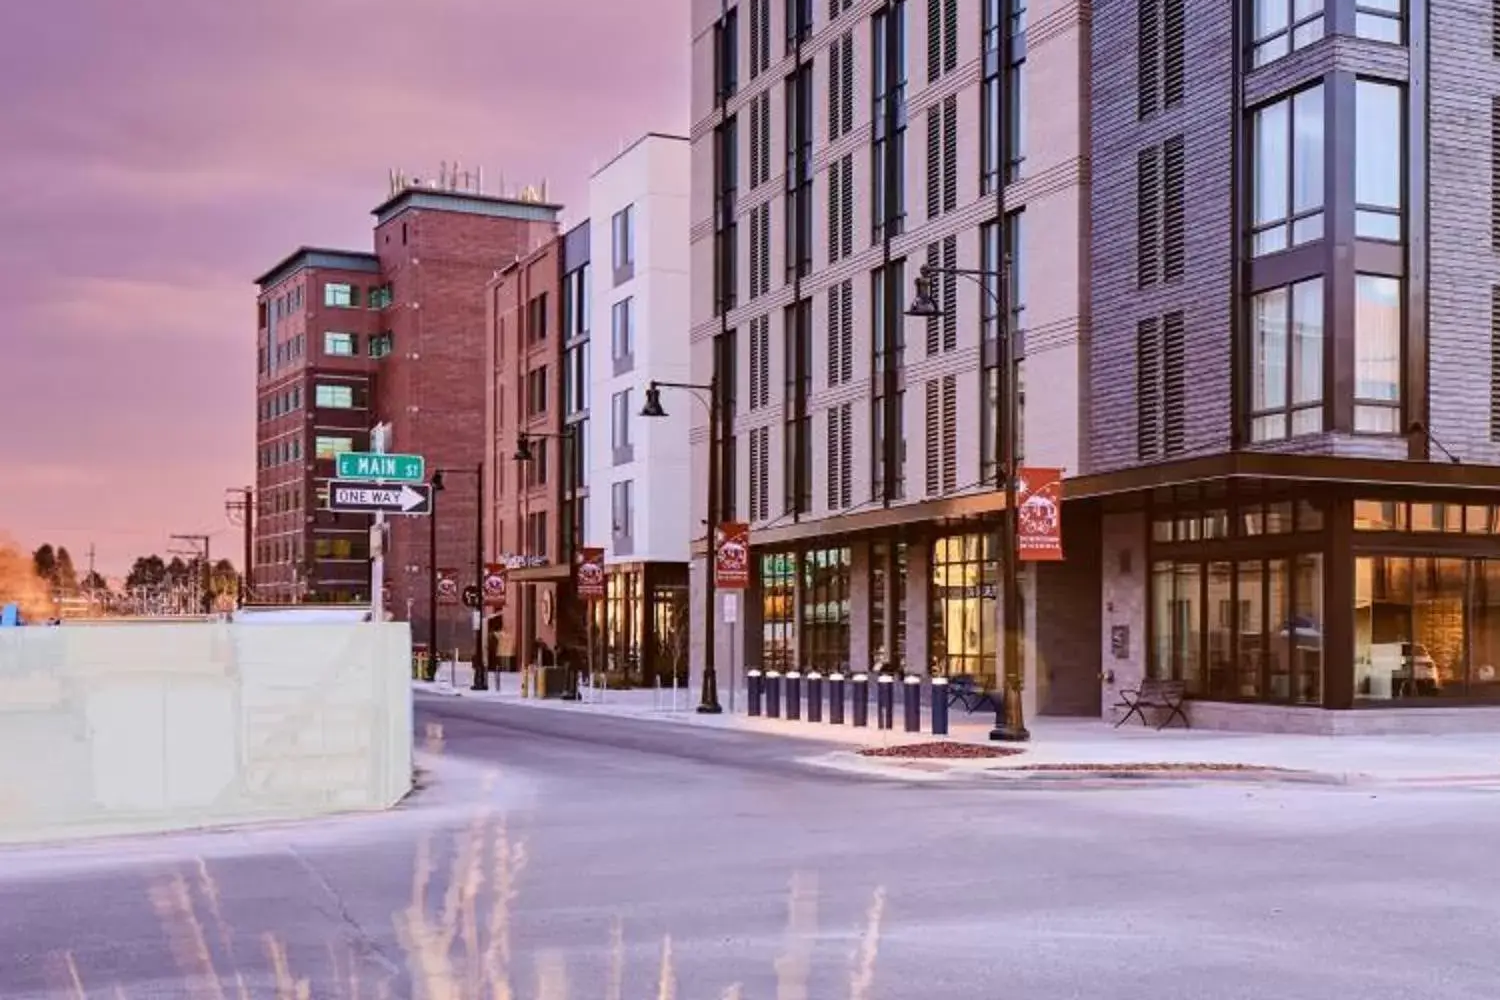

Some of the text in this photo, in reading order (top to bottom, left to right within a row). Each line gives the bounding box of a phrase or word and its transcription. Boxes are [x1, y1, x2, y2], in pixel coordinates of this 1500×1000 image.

[341, 461, 349, 474] E
[357, 457, 396, 475] MAIN
[339, 491, 401, 504] ONE WAY
